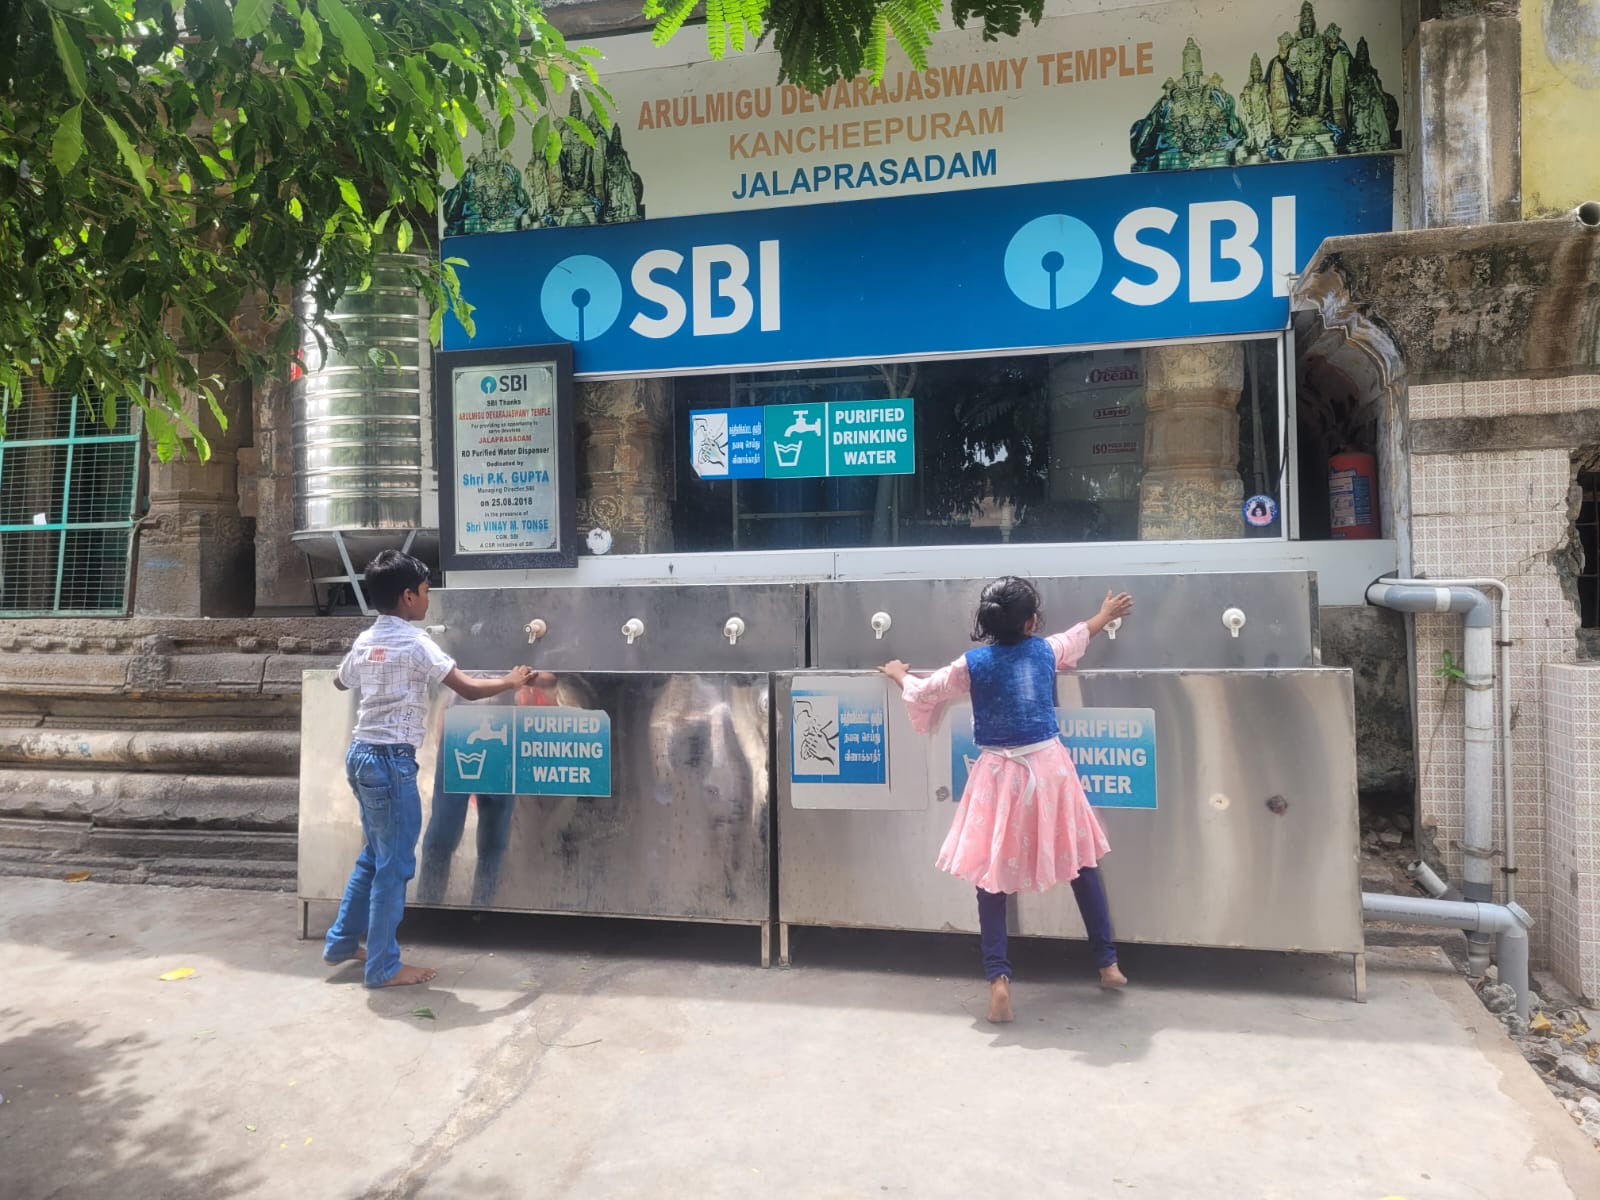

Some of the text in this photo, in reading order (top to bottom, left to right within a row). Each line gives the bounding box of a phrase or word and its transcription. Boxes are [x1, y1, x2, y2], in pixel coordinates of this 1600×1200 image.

[638, 86, 773, 130] ARULMIGU
[1037, 42, 1154, 84] TEMPLE
[729, 106, 1004, 160] KANCHEEPURAM
[732, 148, 998, 200] JALAPRASADAM
[1112, 196, 1296, 306] SBI
[630, 240, 782, 339] SBI
[499, 375, 527, 392] SBI
[531, 408, 551, 416] TEMPLE
[835, 408, 905, 424] PURIFIED
[479, 435, 532, 444] JALAPRASADAM
[833, 428, 907, 445] DRINKING
[472, 449, 496, 457] Purified
[498, 447, 516, 455] Water
[518, 447, 549, 456] Dispenser
[844, 450, 897, 465] WATER
[463, 470, 549, 486] Shri P.K. GUPTA
[466, 522, 480, 533] Shri
[484, 521, 507, 532] VINAY
[521, 519, 549, 530] TONSE
[524, 717, 600, 733] PURIFIED
[1060, 719, 1144, 738] URIFIED
[521, 741, 603, 758] DRINKING
[533, 767, 591, 783] WATER
[1080, 775, 1132, 794] ATER
